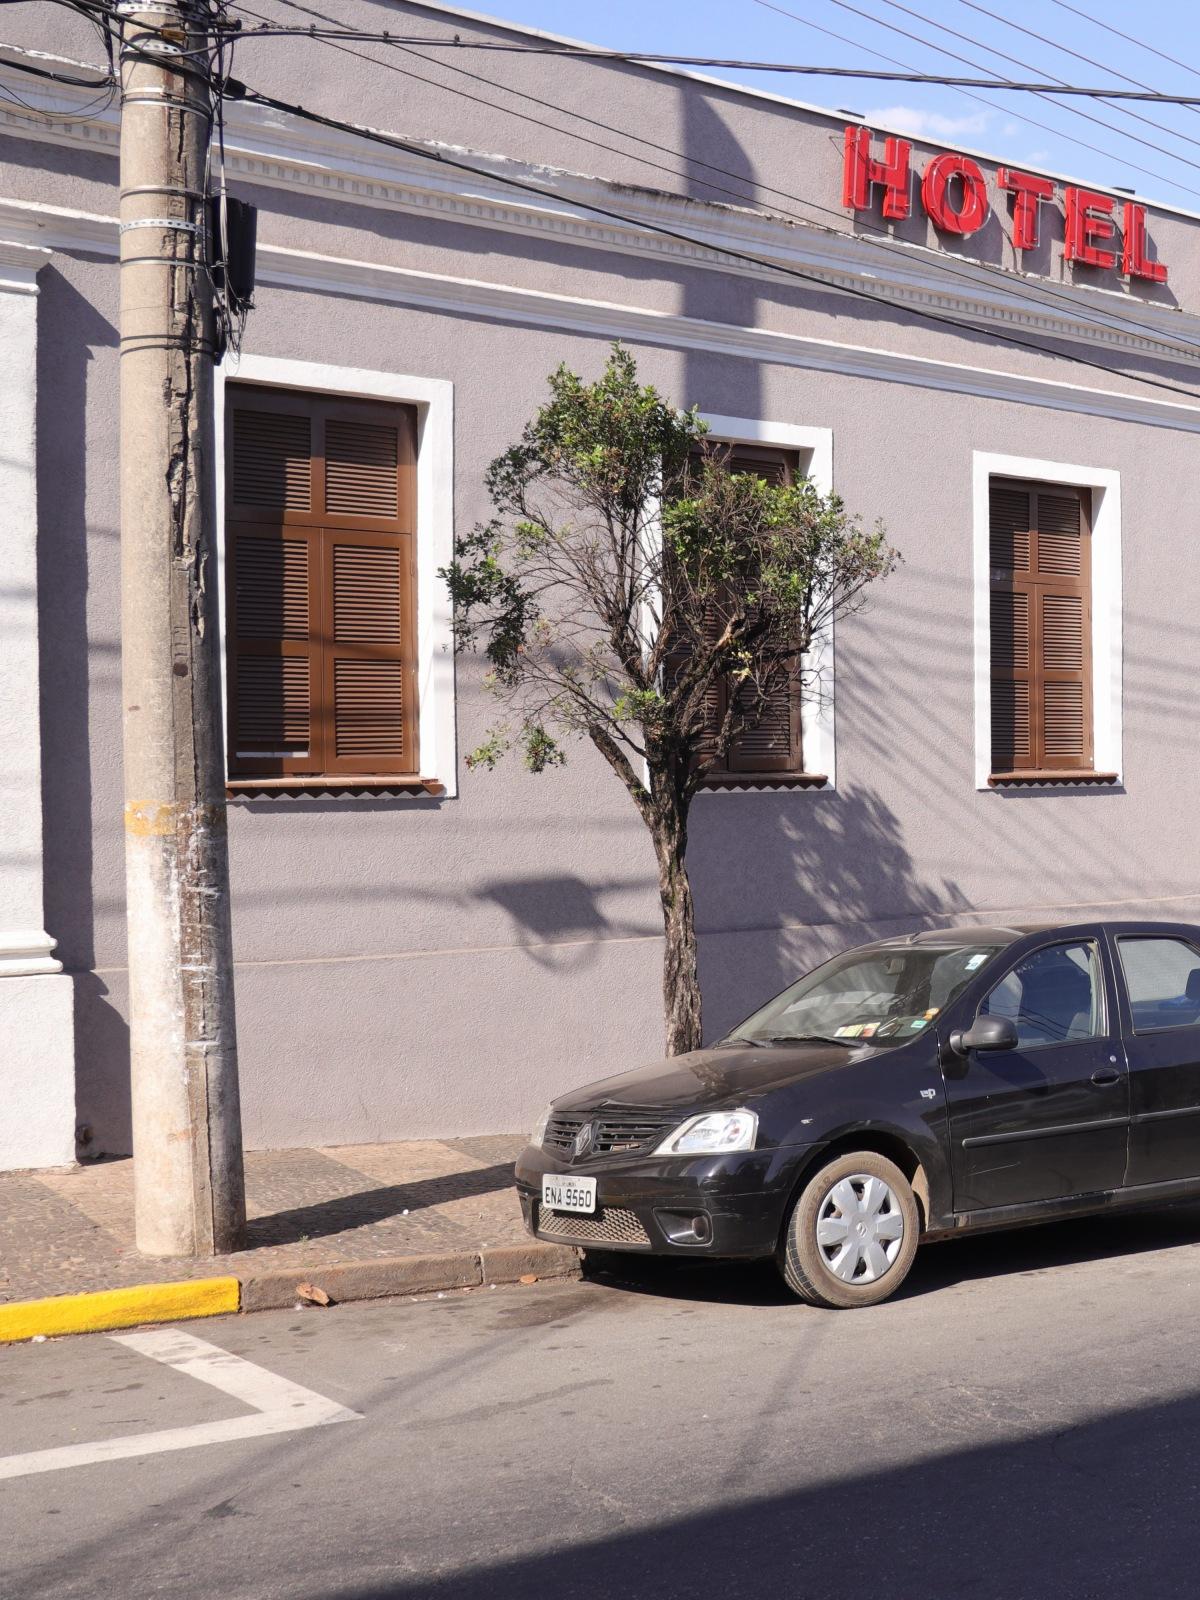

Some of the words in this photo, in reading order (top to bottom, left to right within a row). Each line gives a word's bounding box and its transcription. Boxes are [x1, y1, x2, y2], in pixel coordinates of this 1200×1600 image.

[843, 125, 1168, 283] HOTEL
[545, 1186, 562, 1205] ENA
[565, 1188, 592, 1208] 9560
